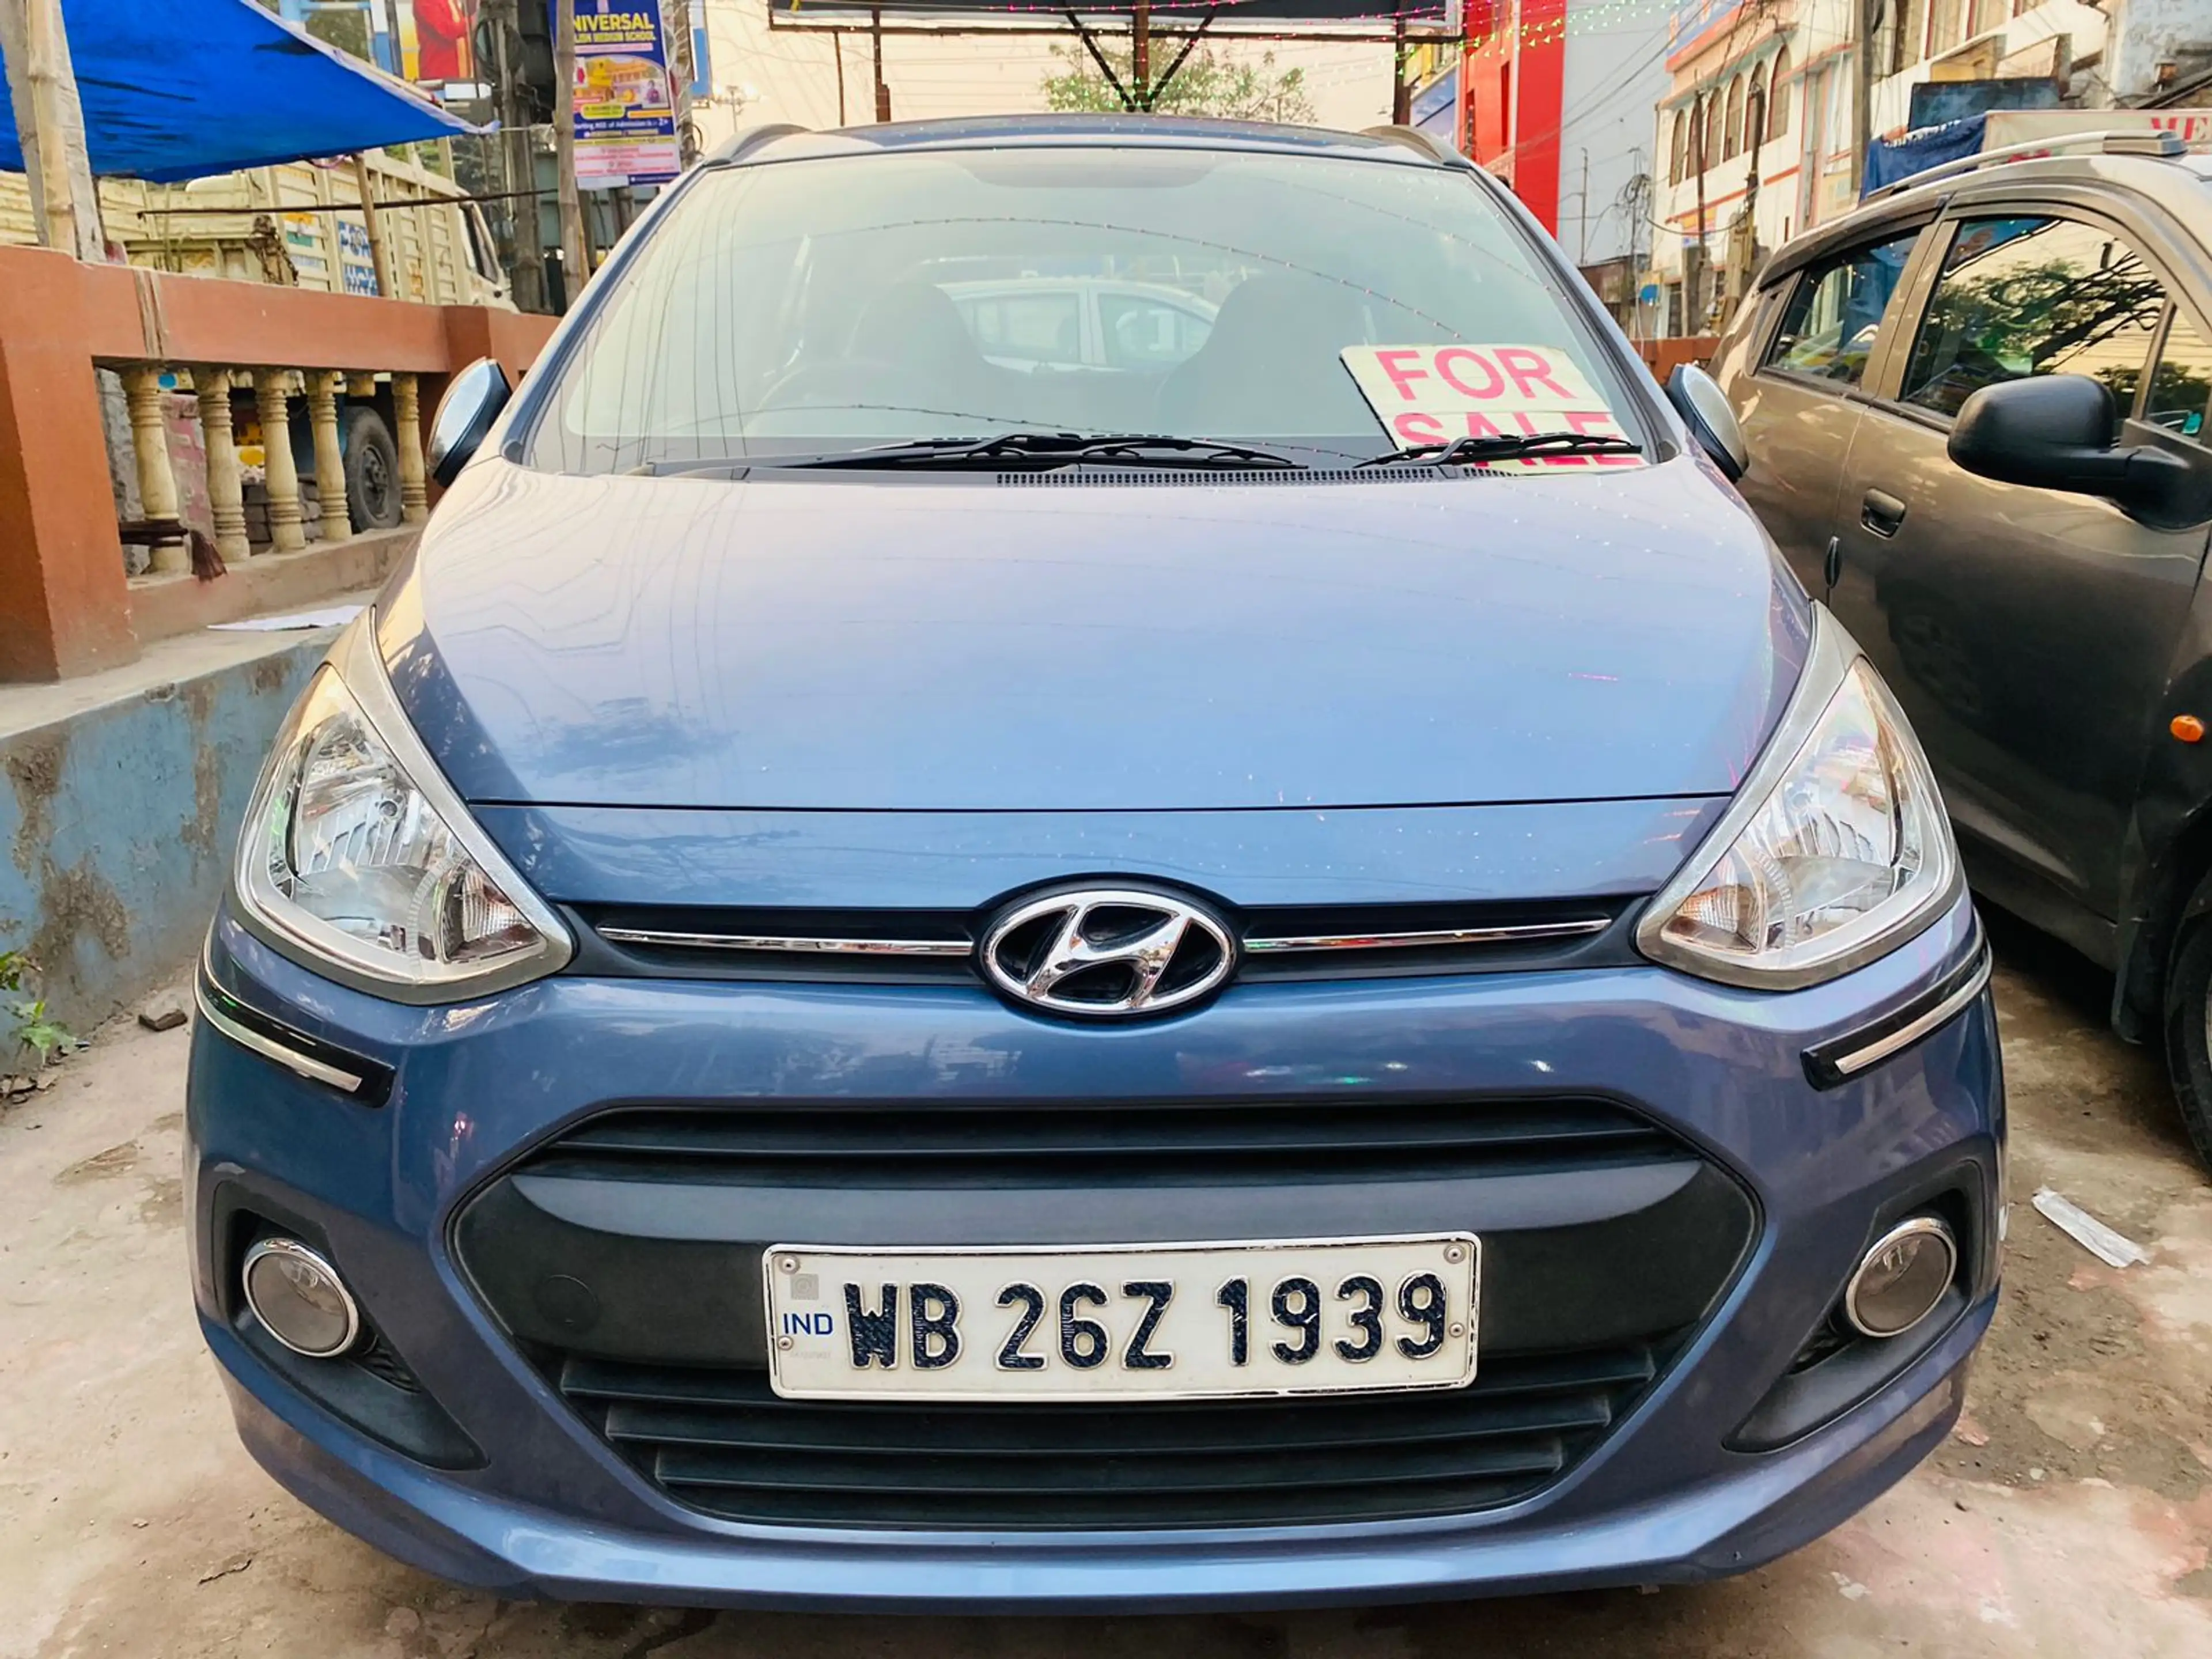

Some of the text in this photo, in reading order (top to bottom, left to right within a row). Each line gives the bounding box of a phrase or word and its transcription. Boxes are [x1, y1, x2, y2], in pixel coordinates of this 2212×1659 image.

[574, 13, 655, 31] NIVERSAL
[1375, 348, 1577, 401] FOR
[783, 1313, 833, 1335] IND
[843, 1270, 1448, 1370] WB 26Z 1939
